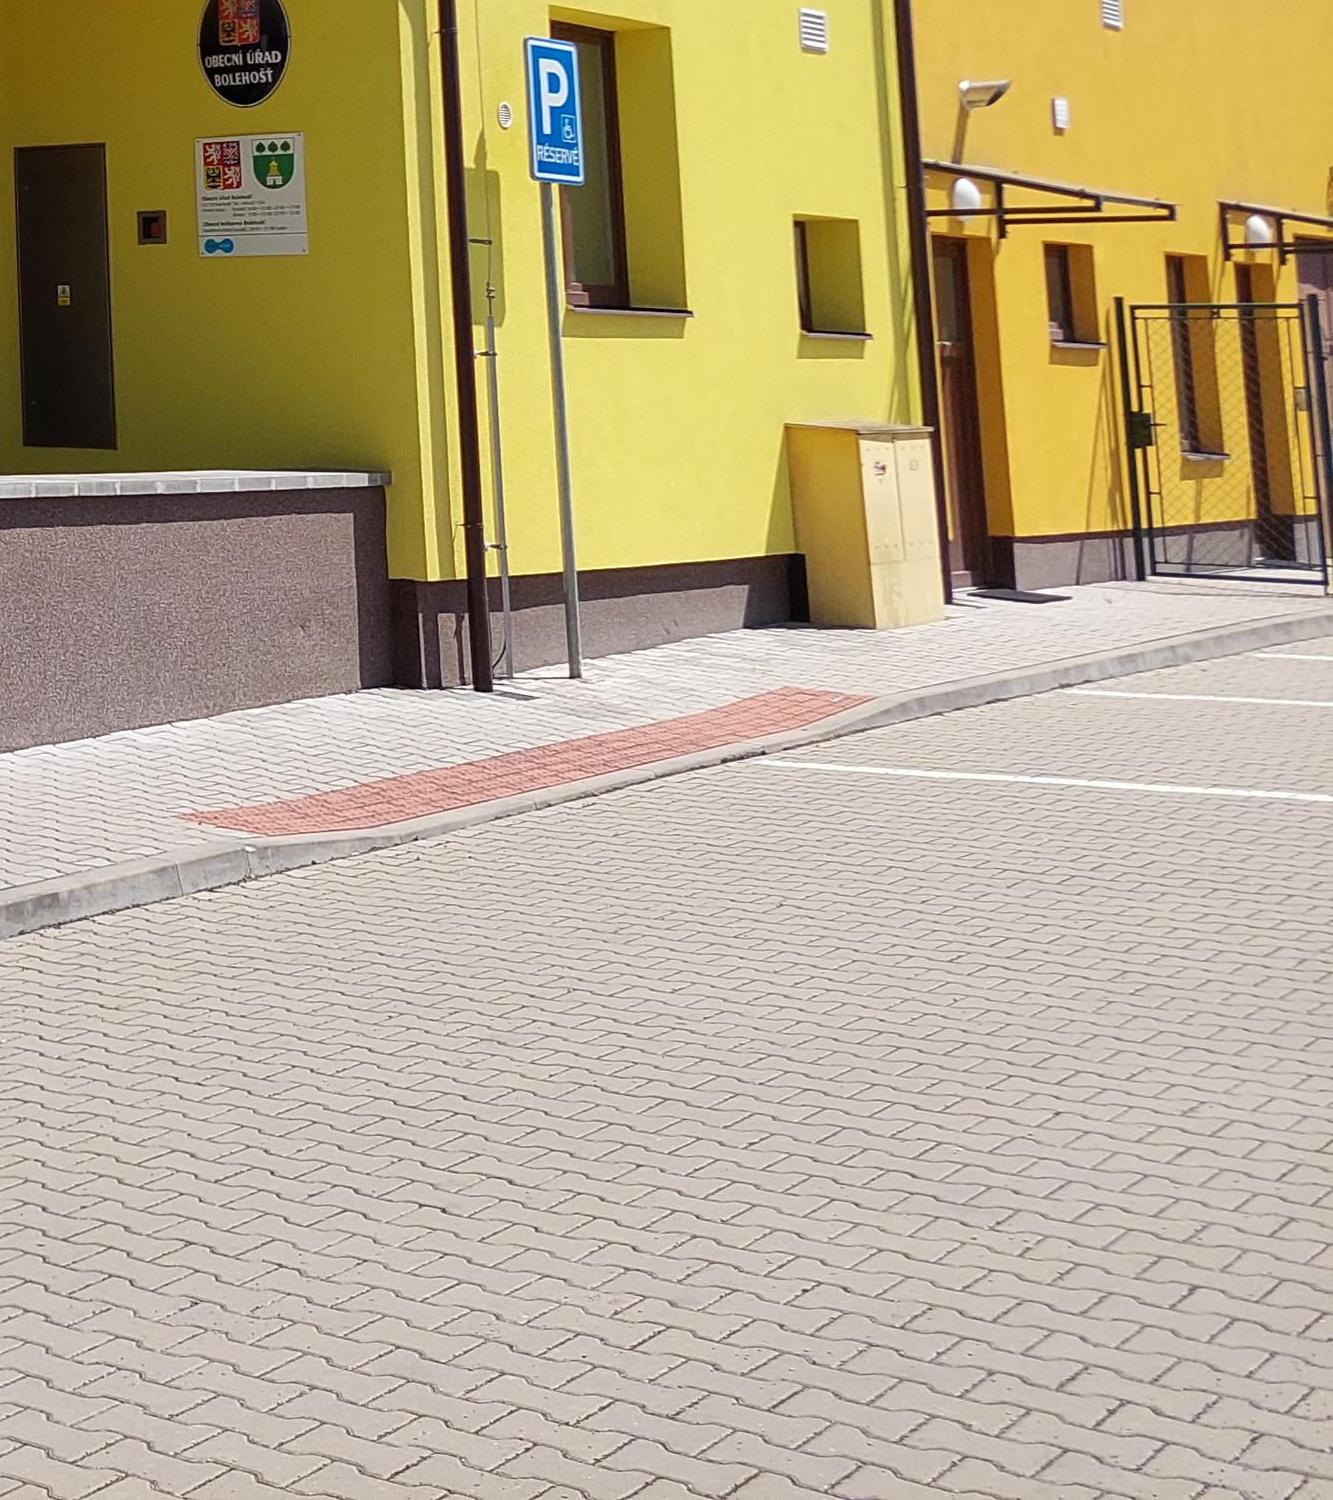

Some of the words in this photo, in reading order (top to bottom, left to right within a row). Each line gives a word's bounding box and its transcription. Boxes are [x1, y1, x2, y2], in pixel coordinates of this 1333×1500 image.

[205, 50, 243, 68] OBECNÍ
[214, 67, 274, 87] BOLEHOŠŤ
[538, 58, 569, 135] P
